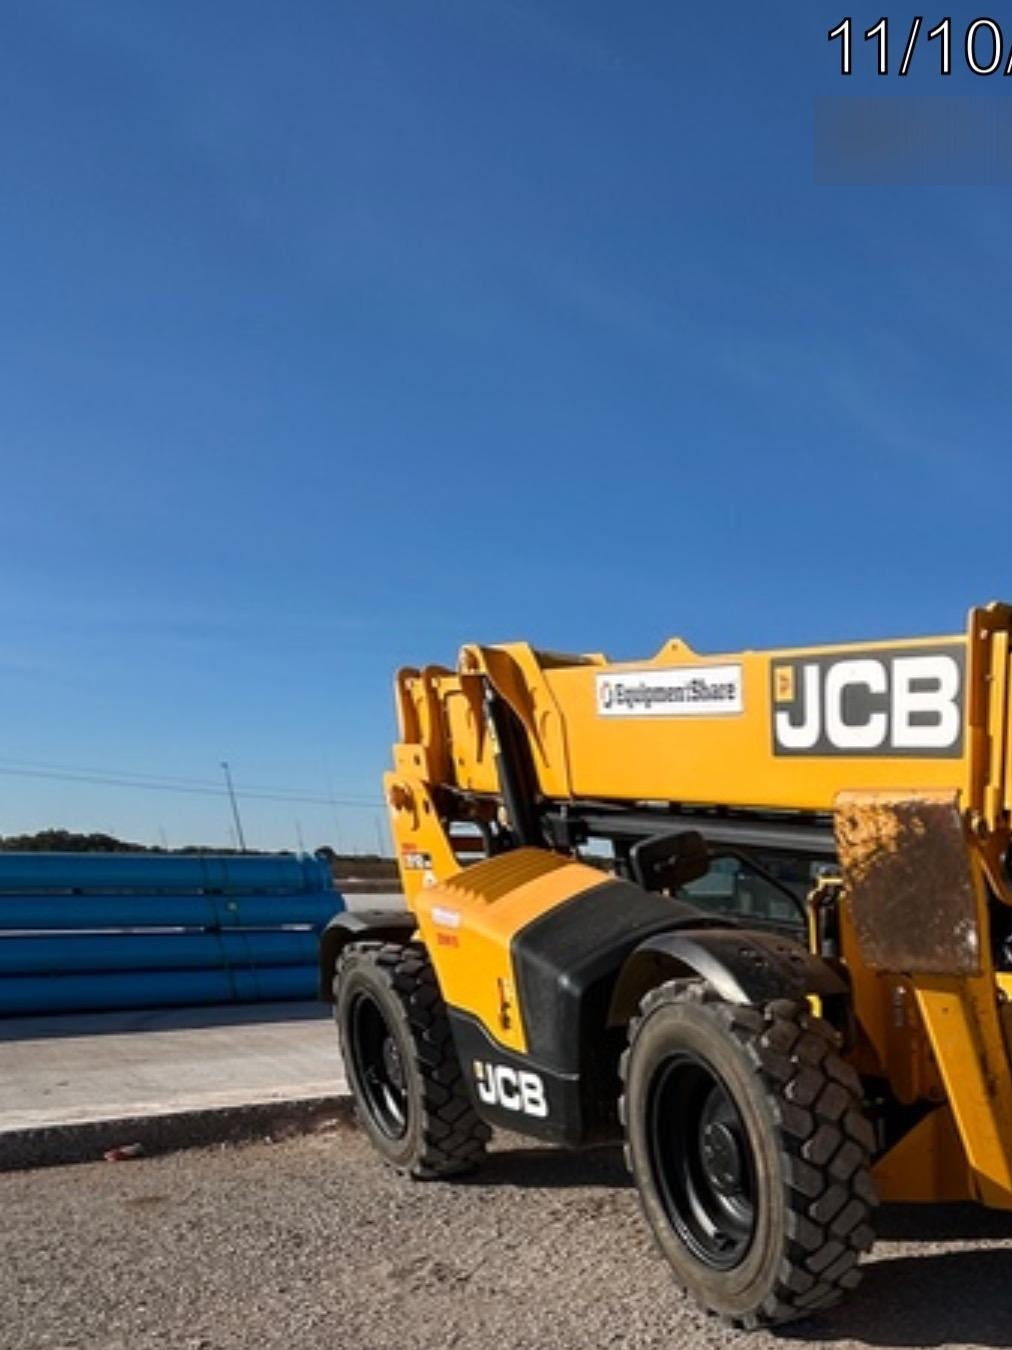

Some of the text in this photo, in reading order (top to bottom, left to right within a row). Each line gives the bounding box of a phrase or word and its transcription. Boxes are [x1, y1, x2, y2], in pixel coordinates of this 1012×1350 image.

[615, 678, 736, 709] EquipmentShare
[776, 656, 960, 749] JCB
[476, 1061, 548, 1118] JCB
